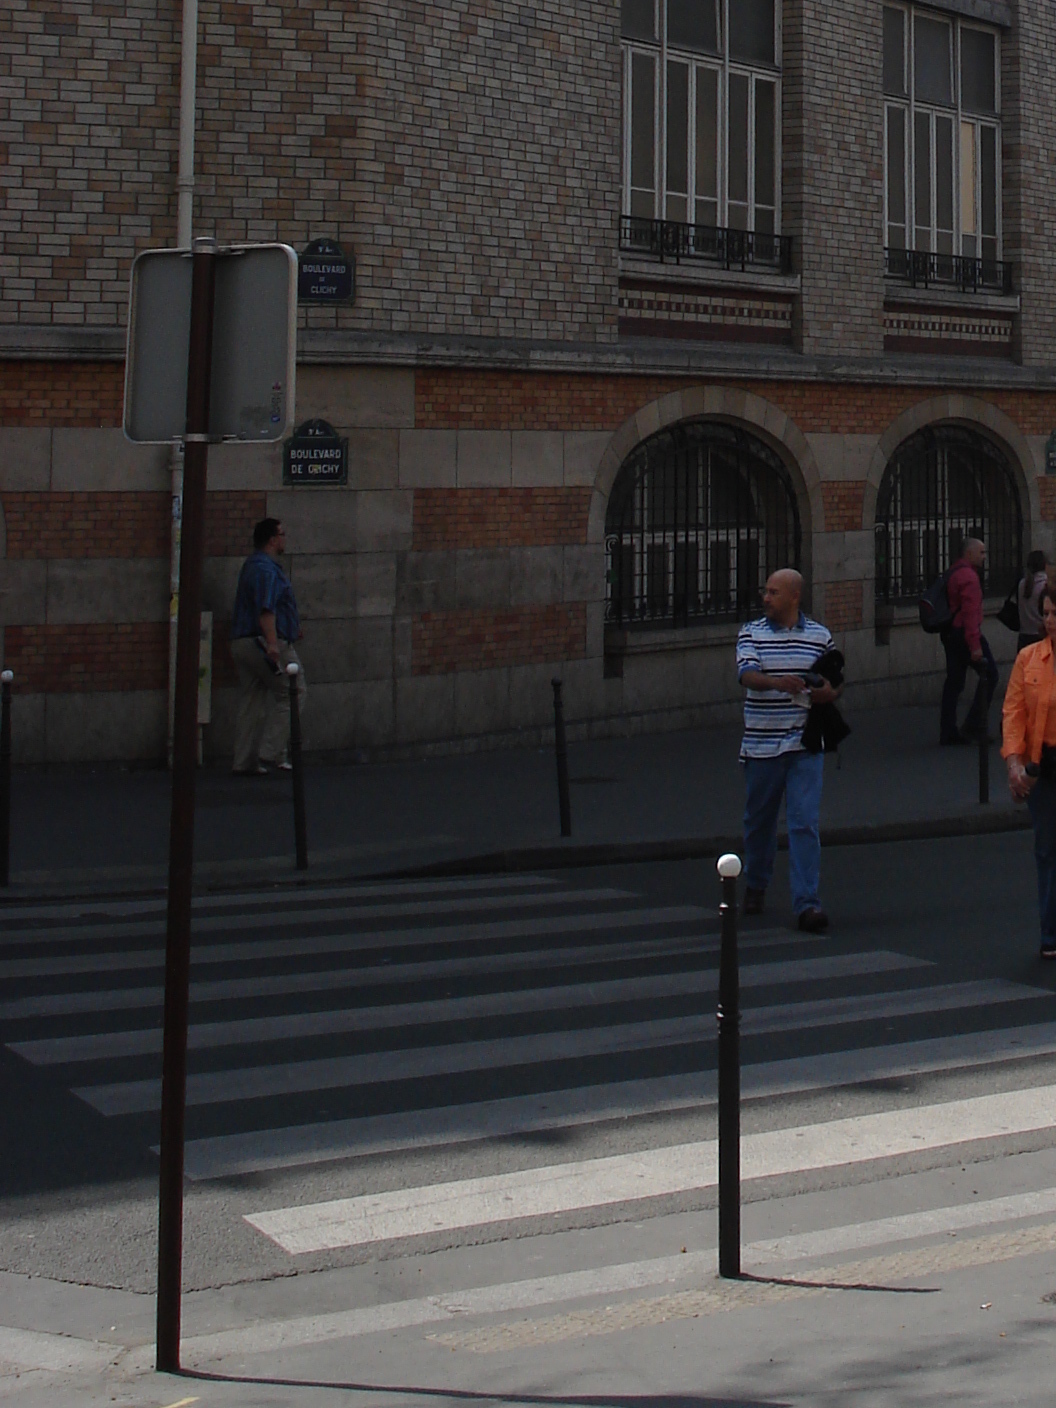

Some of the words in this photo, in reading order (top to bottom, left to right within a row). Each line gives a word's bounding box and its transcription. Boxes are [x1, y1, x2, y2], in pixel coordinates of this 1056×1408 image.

[302, 264, 346, 274] BOULEVARD
[310, 285, 338, 294] CLICHY
[290, 449, 342, 459] BOULEVARD
[291, 464, 303, 474] DE
[308, 464, 340, 474] CLICHY
